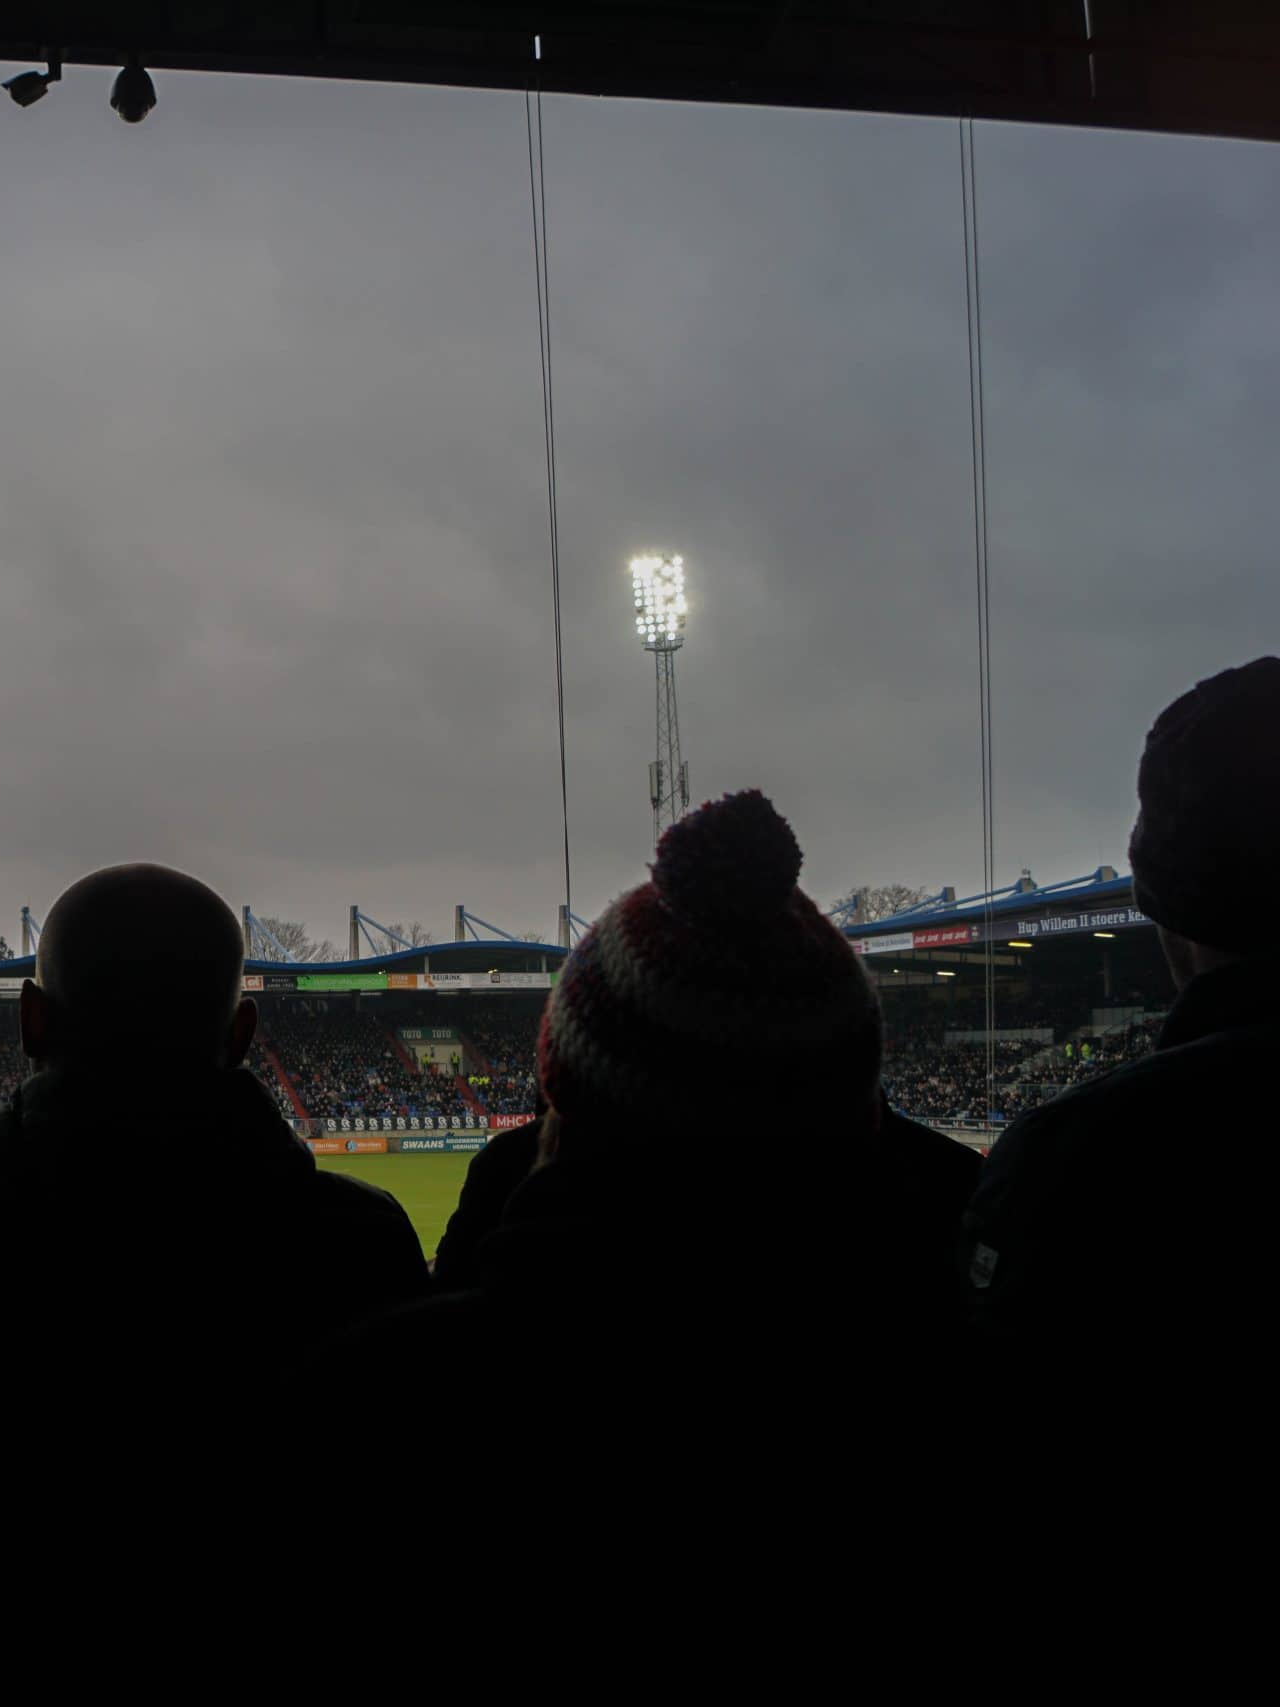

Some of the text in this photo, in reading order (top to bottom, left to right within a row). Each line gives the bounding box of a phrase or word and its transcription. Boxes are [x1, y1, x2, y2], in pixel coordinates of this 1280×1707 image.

[1017, 921, 1039, 936] Hup
[1040, 917, 1077, 931] Willem
[1079, 914, 1089, 927] II
[1090, 911, 1125, 926] stoere
[402, 1030, 422, 1039] TOTO
[432, 1030, 452, 1039] TOTO
[496, 1114, 524, 1128] MHC
[402, 1140, 445, 1149] SWAANS
